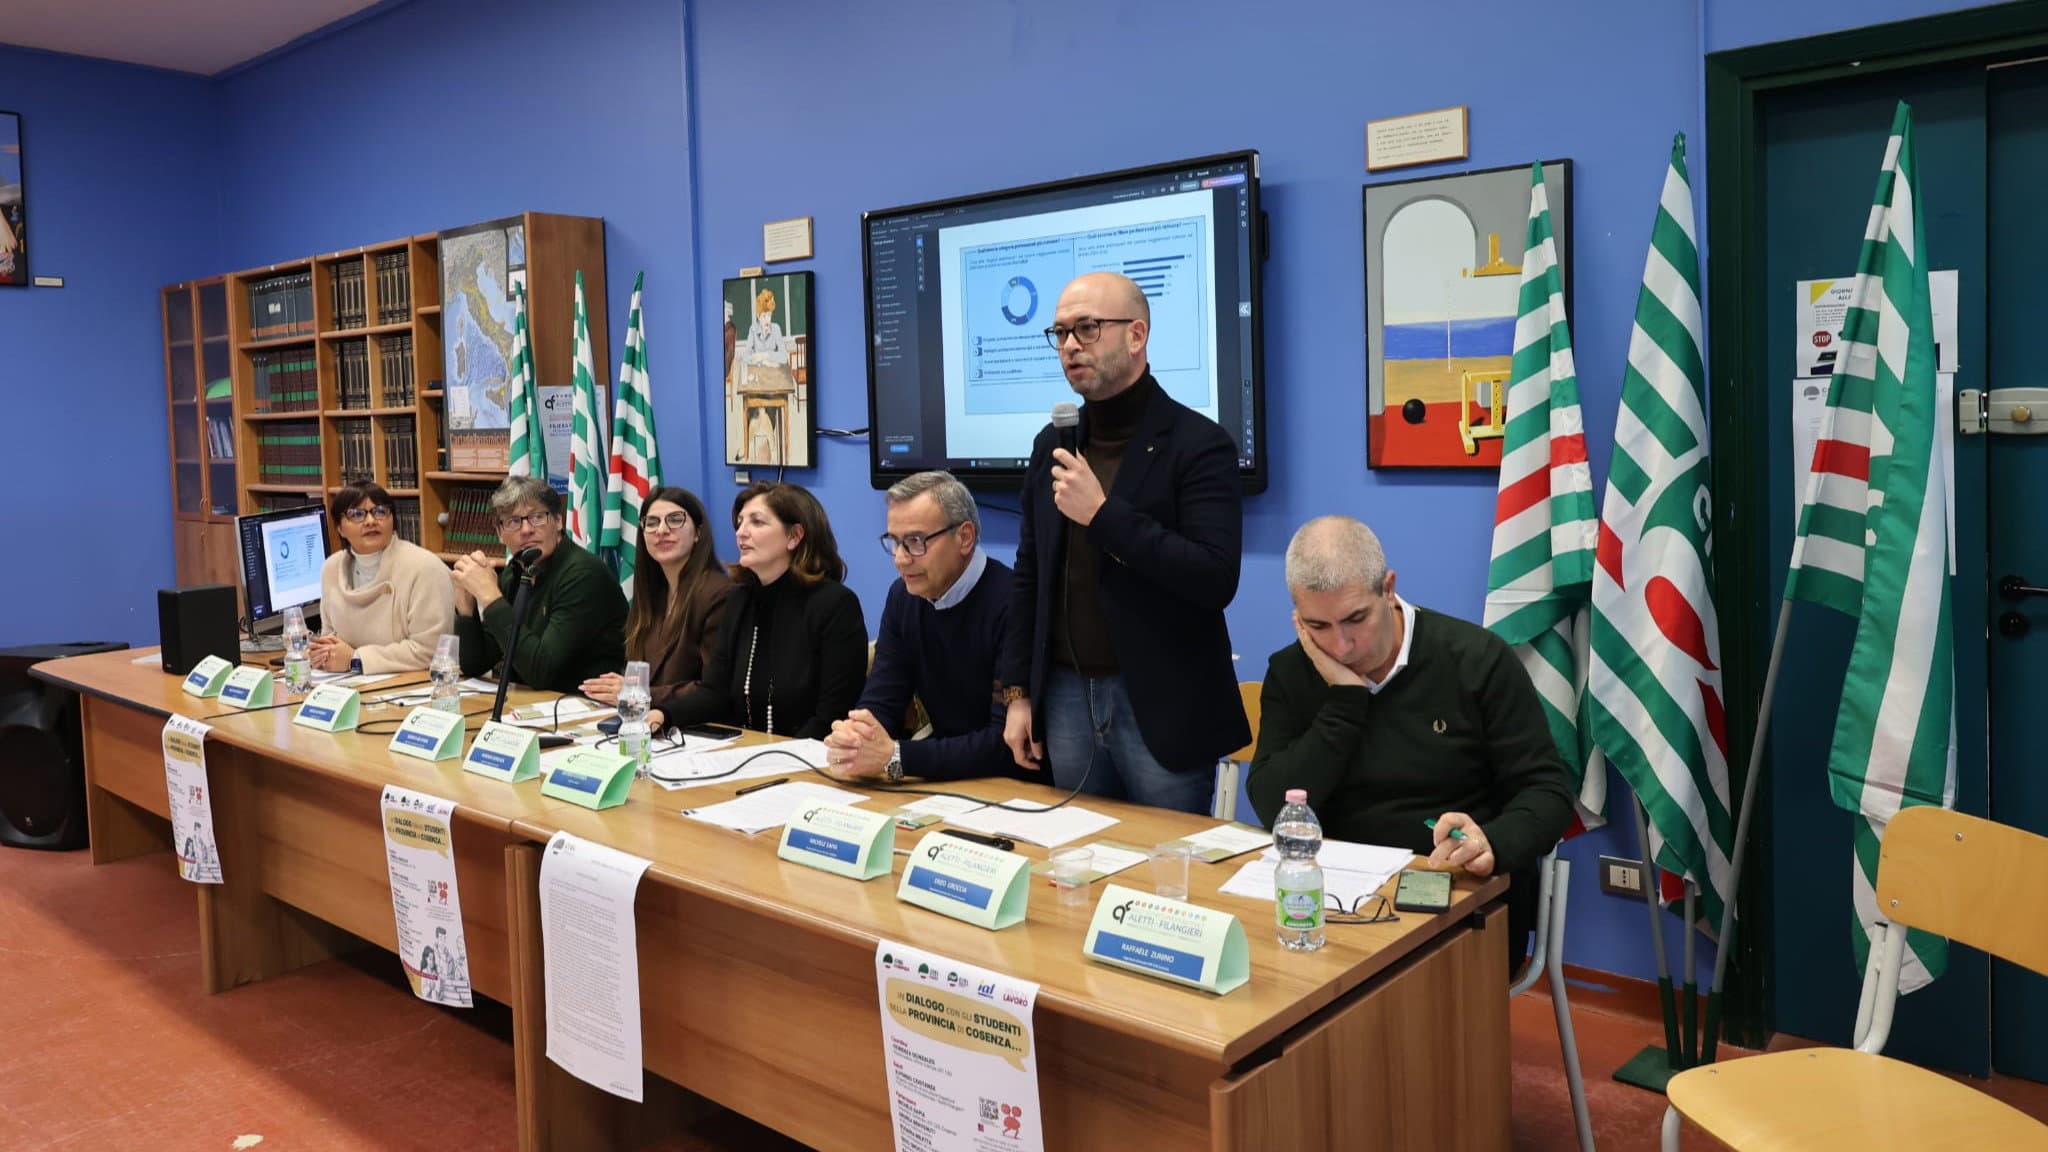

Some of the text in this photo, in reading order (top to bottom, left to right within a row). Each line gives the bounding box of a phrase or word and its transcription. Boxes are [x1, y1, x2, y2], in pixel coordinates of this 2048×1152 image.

[1813, 335, 1831, 344] STOP
[1159, 919, 1203, 937] FILANGIERI
[1121, 943, 1149, 957] RAFFAELE
[977, 979, 996, 996] ial
[1003, 993, 1028, 1008] LAVORO
[906, 991, 945, 1012] DIALOGO
[946, 1007, 961, 1018] CON
[962, 1012, 973, 1022] GLI
[973, 1013, 1021, 1037] STUDENTI
[908, 1009, 956, 1032] PROVINCIA
[957, 1024, 965, 1034] DI
